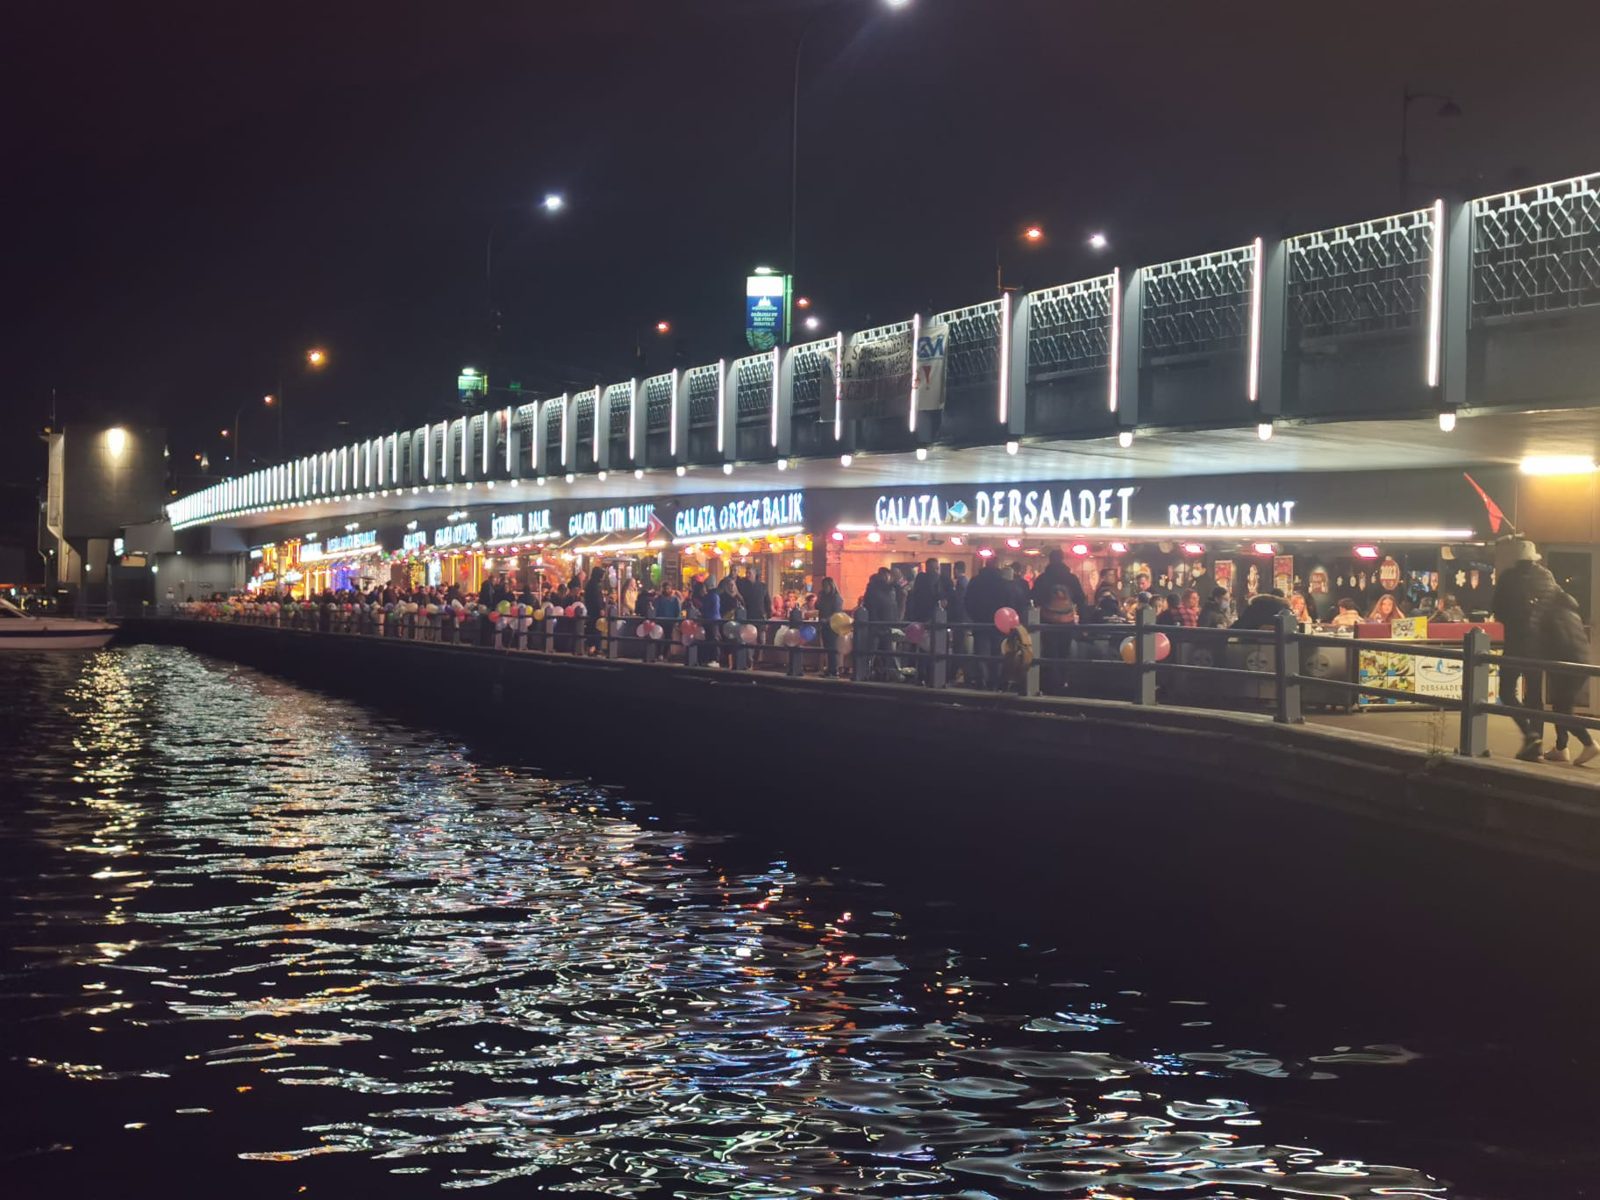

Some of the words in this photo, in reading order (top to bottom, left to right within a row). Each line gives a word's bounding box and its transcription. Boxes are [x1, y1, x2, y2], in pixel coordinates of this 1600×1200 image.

[528, 509, 551, 532] BALIK
[675, 506, 716, 537] GALATA
[719, 499, 760, 529] ORFOZ
[763, 492, 804, 524] BALIK
[875, 494, 942, 526] GALATA
[975, 486, 1135, 527] DERSAADET
[1168, 500, 1295, 527] RESTAURANT
[568, 512, 598, 537] GALATA
